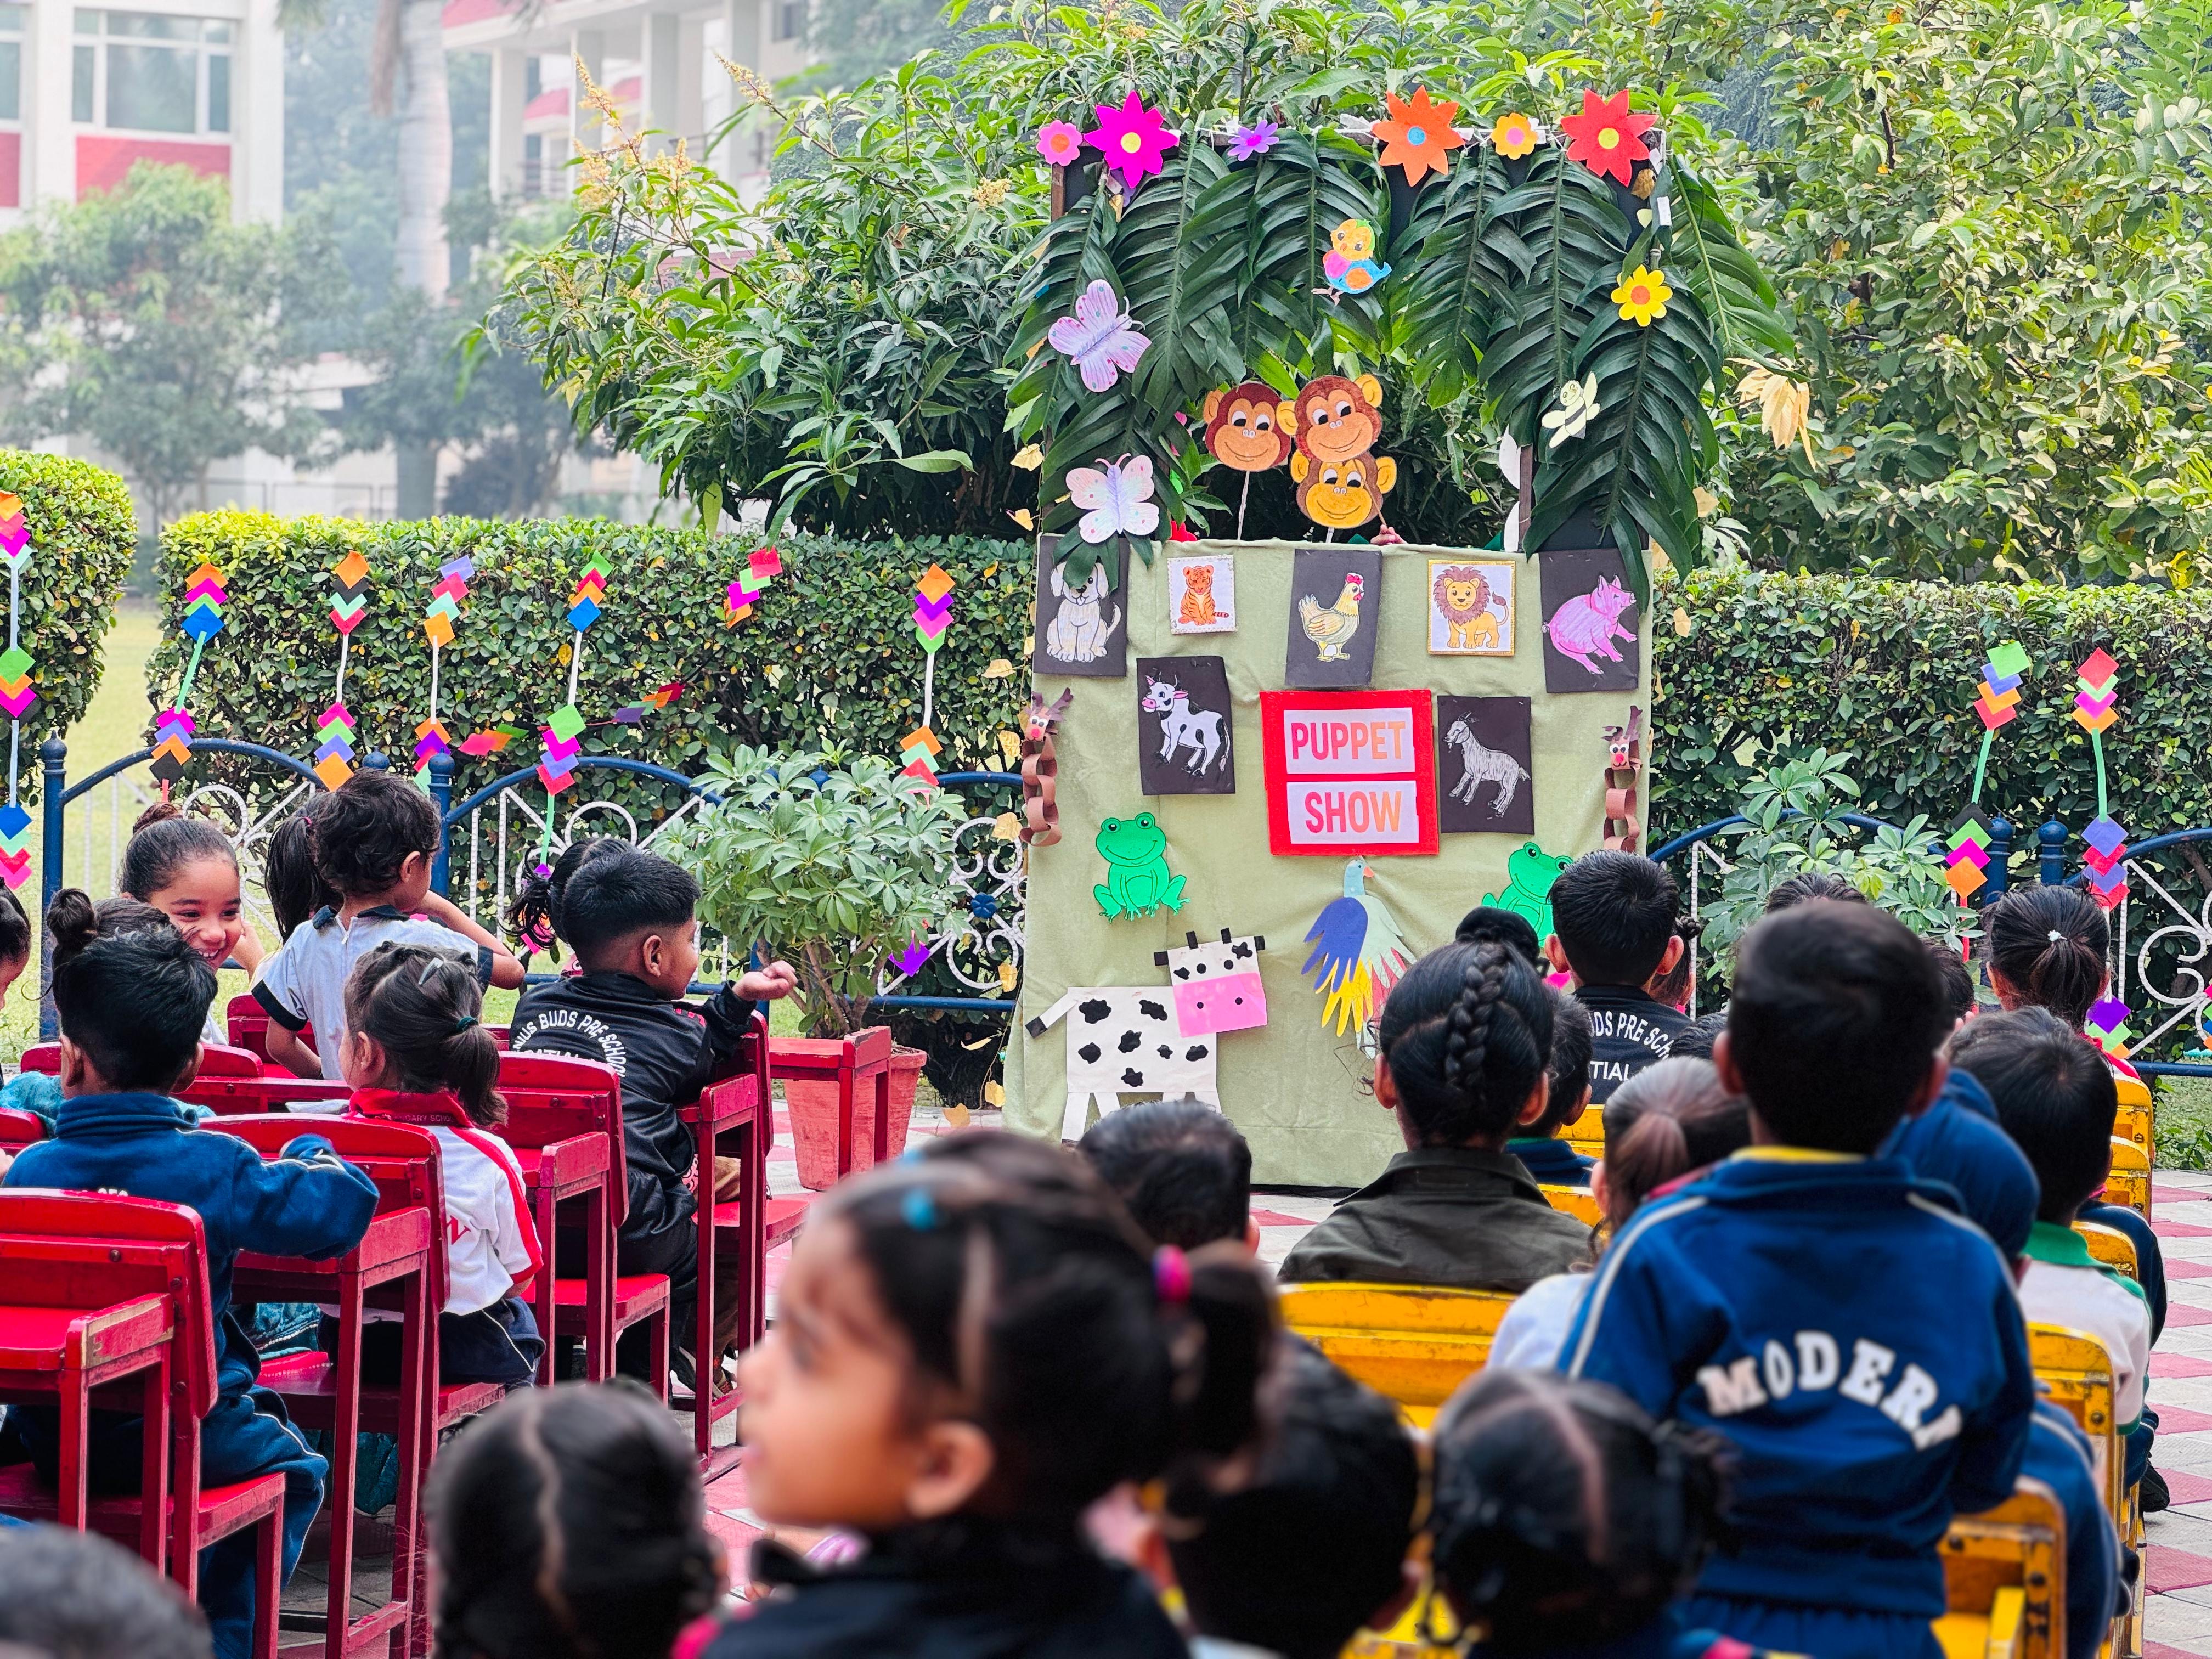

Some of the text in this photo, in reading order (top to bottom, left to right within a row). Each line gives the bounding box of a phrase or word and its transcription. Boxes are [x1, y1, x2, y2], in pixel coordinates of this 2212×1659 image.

[1290, 721, 1406, 760] PUPPET
[1304, 791, 1402, 834] SHOW
[512, 1021, 538, 1052] NIUS
[538, 1009, 578, 1030] BUDS
[577, 1015, 610, 1039] PRE
[1589, 1011, 1675, 1060] DS PRE SCH
[1589, 1060, 1630, 1081] TIAL
